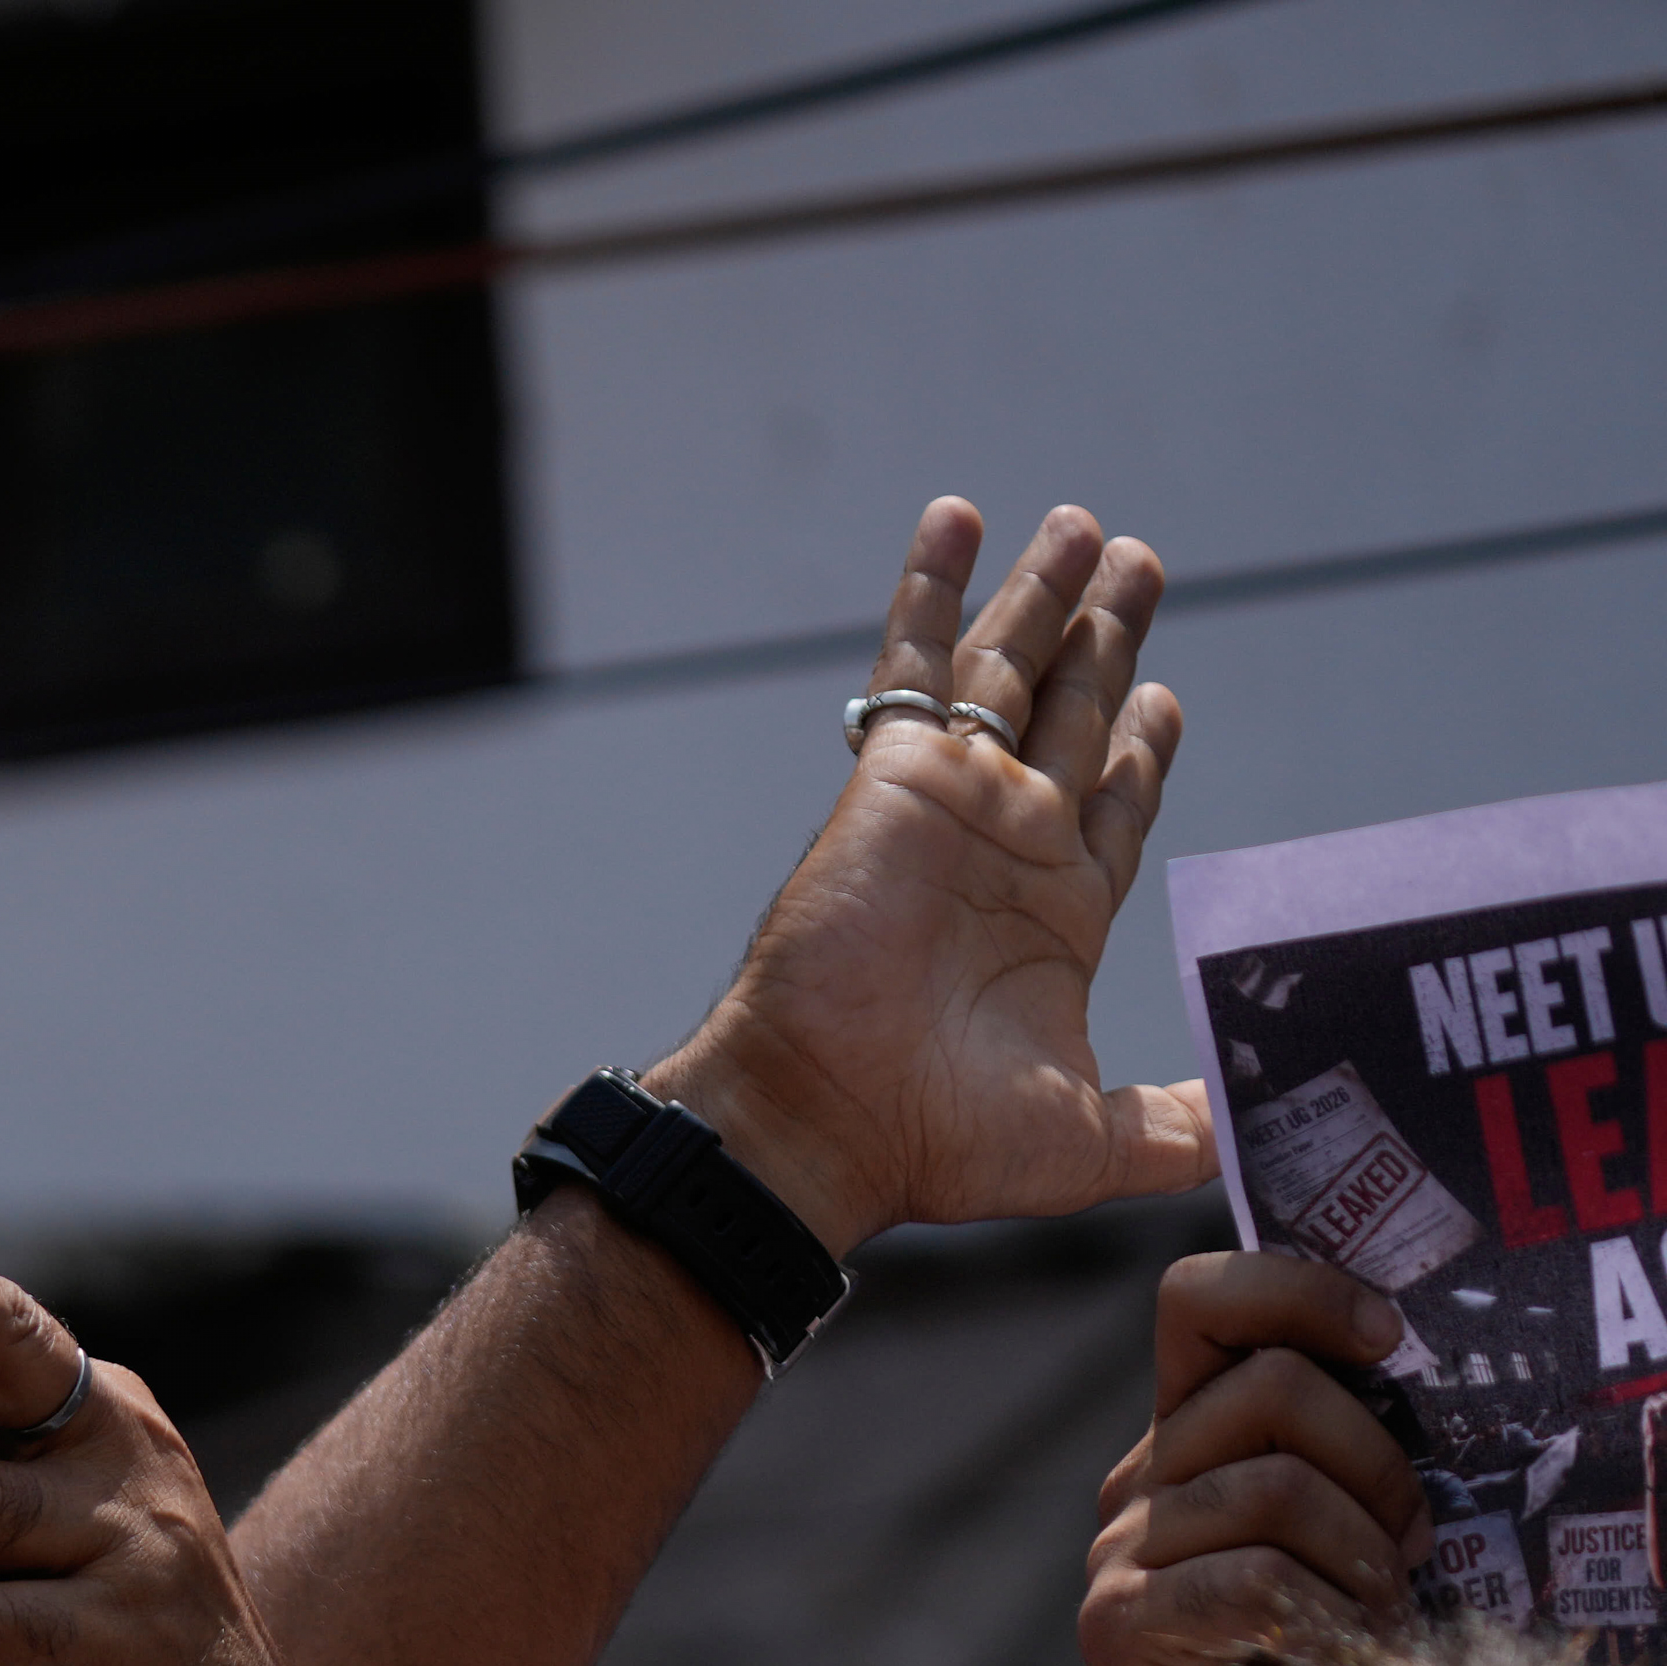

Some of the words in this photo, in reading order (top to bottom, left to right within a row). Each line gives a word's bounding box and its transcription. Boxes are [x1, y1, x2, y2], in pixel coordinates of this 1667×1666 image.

[1408, 925, 1616, 1078] NEET
[1287, 1106, 1313, 1130] UG
[1311, 1086, 1351, 1118] 2026
[1308, 1150, 1409, 1250] LEAKED
[1590, 1229, 1667, 1370] A
[1558, 1523, 1646, 1555] JUSTICE
[1586, 1557, 1622, 1582] FOR
[1559, 1584, 1652, 1614] STUDENTS
